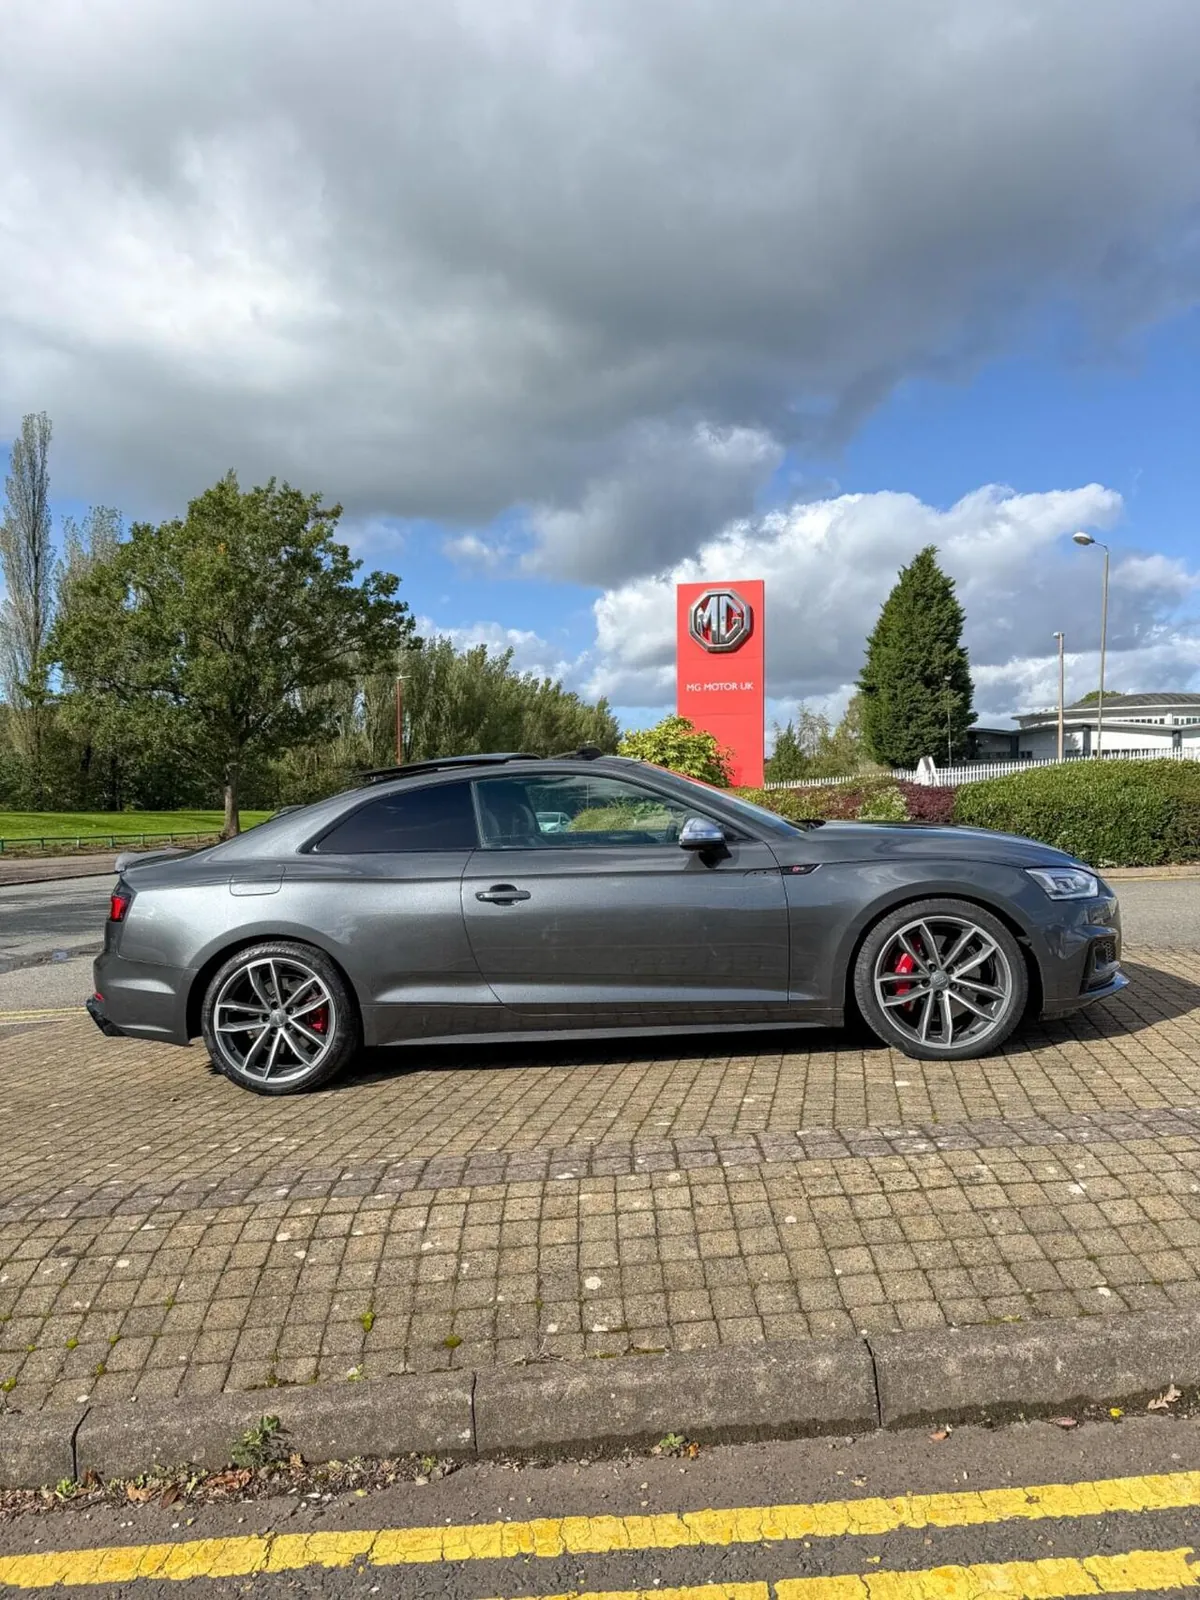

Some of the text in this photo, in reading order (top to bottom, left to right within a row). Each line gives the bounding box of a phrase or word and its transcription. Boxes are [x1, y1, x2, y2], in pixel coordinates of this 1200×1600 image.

[695, 593, 743, 646] MG
[686, 682, 754, 692] MG MOTOR UK
